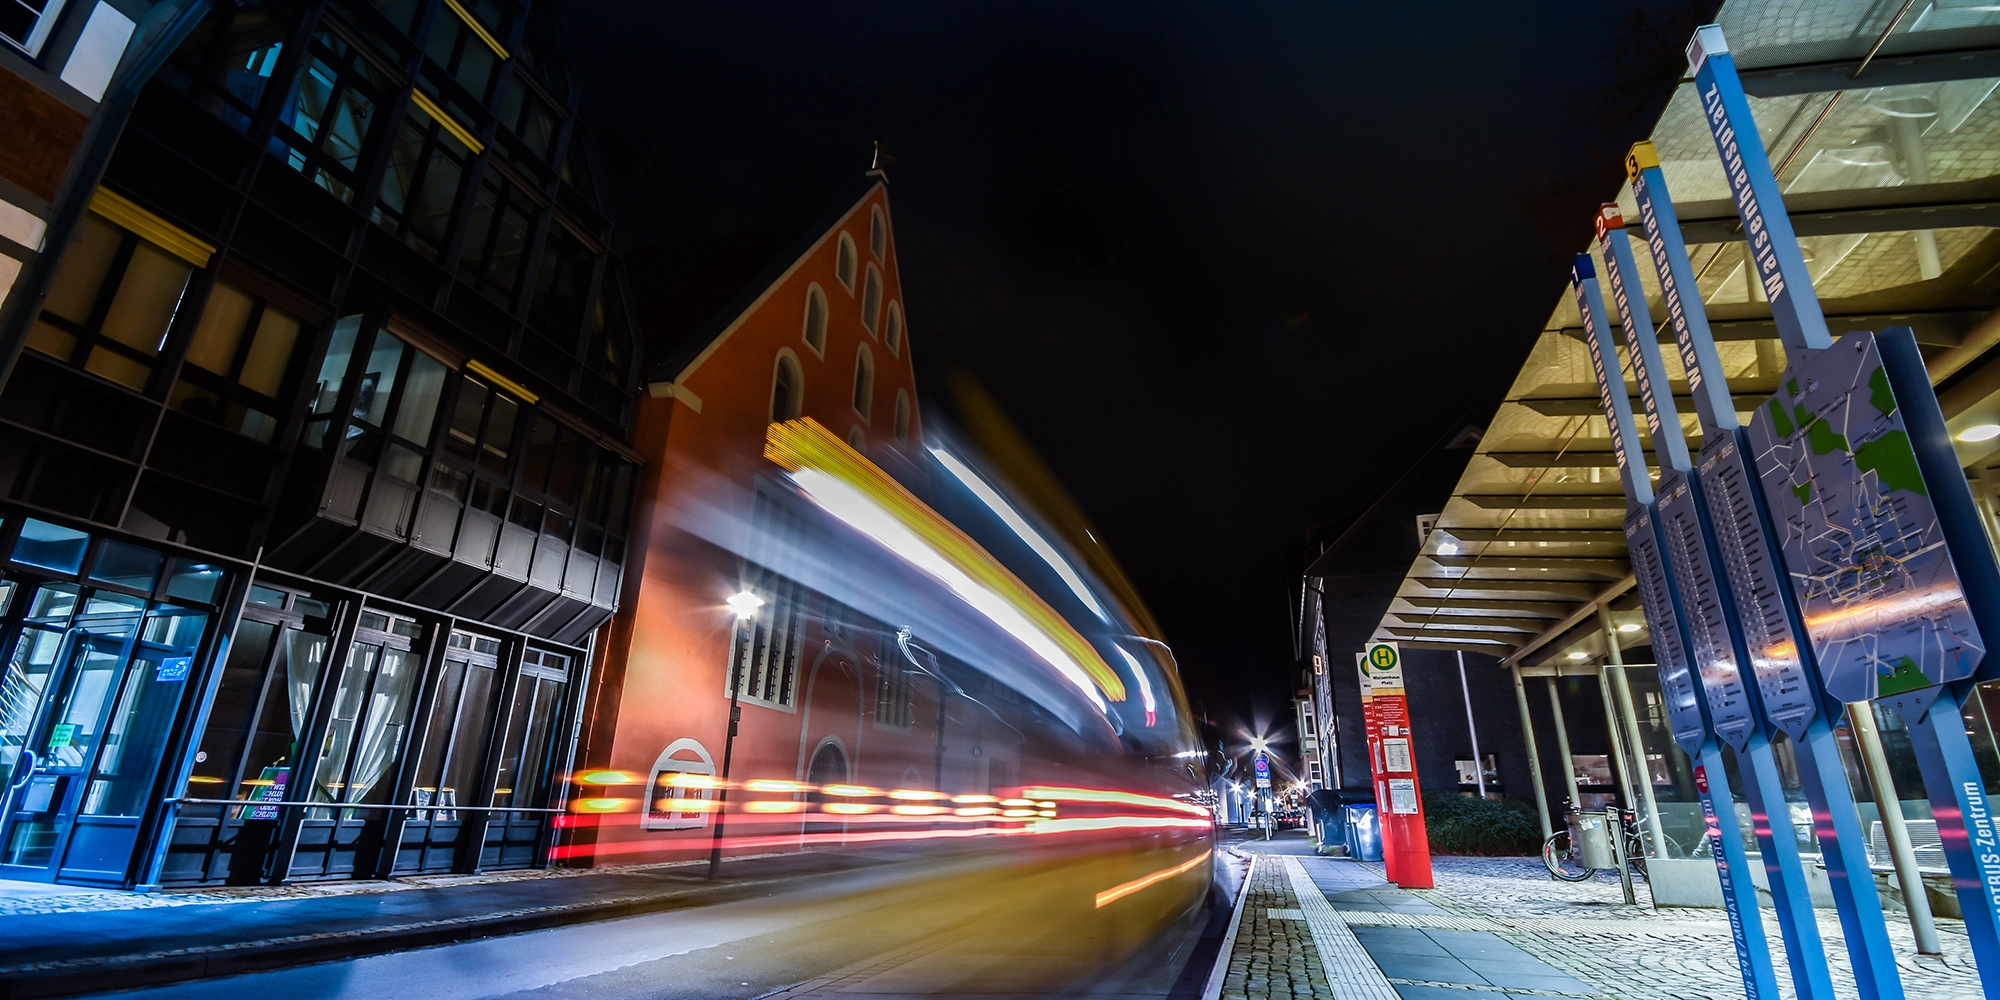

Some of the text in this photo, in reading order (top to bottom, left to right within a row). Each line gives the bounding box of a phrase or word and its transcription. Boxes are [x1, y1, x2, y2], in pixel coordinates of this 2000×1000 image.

[1629, 155, 1638, 177] 3
[1705, 82, 1785, 303] Waisenhausplatz
[1597, 216, 1606, 238] 2
[1572, 265, 1578, 282] 1
[1641, 197, 1702, 392] Waisenhausplatz
[1608, 256, 1660, 435] Waisenhausplatz
[1582, 303, 1627, 469] Waisenhausplatz
[1377, 650, 1390, 665] H
[1742, 960, 1752, 977] 29
